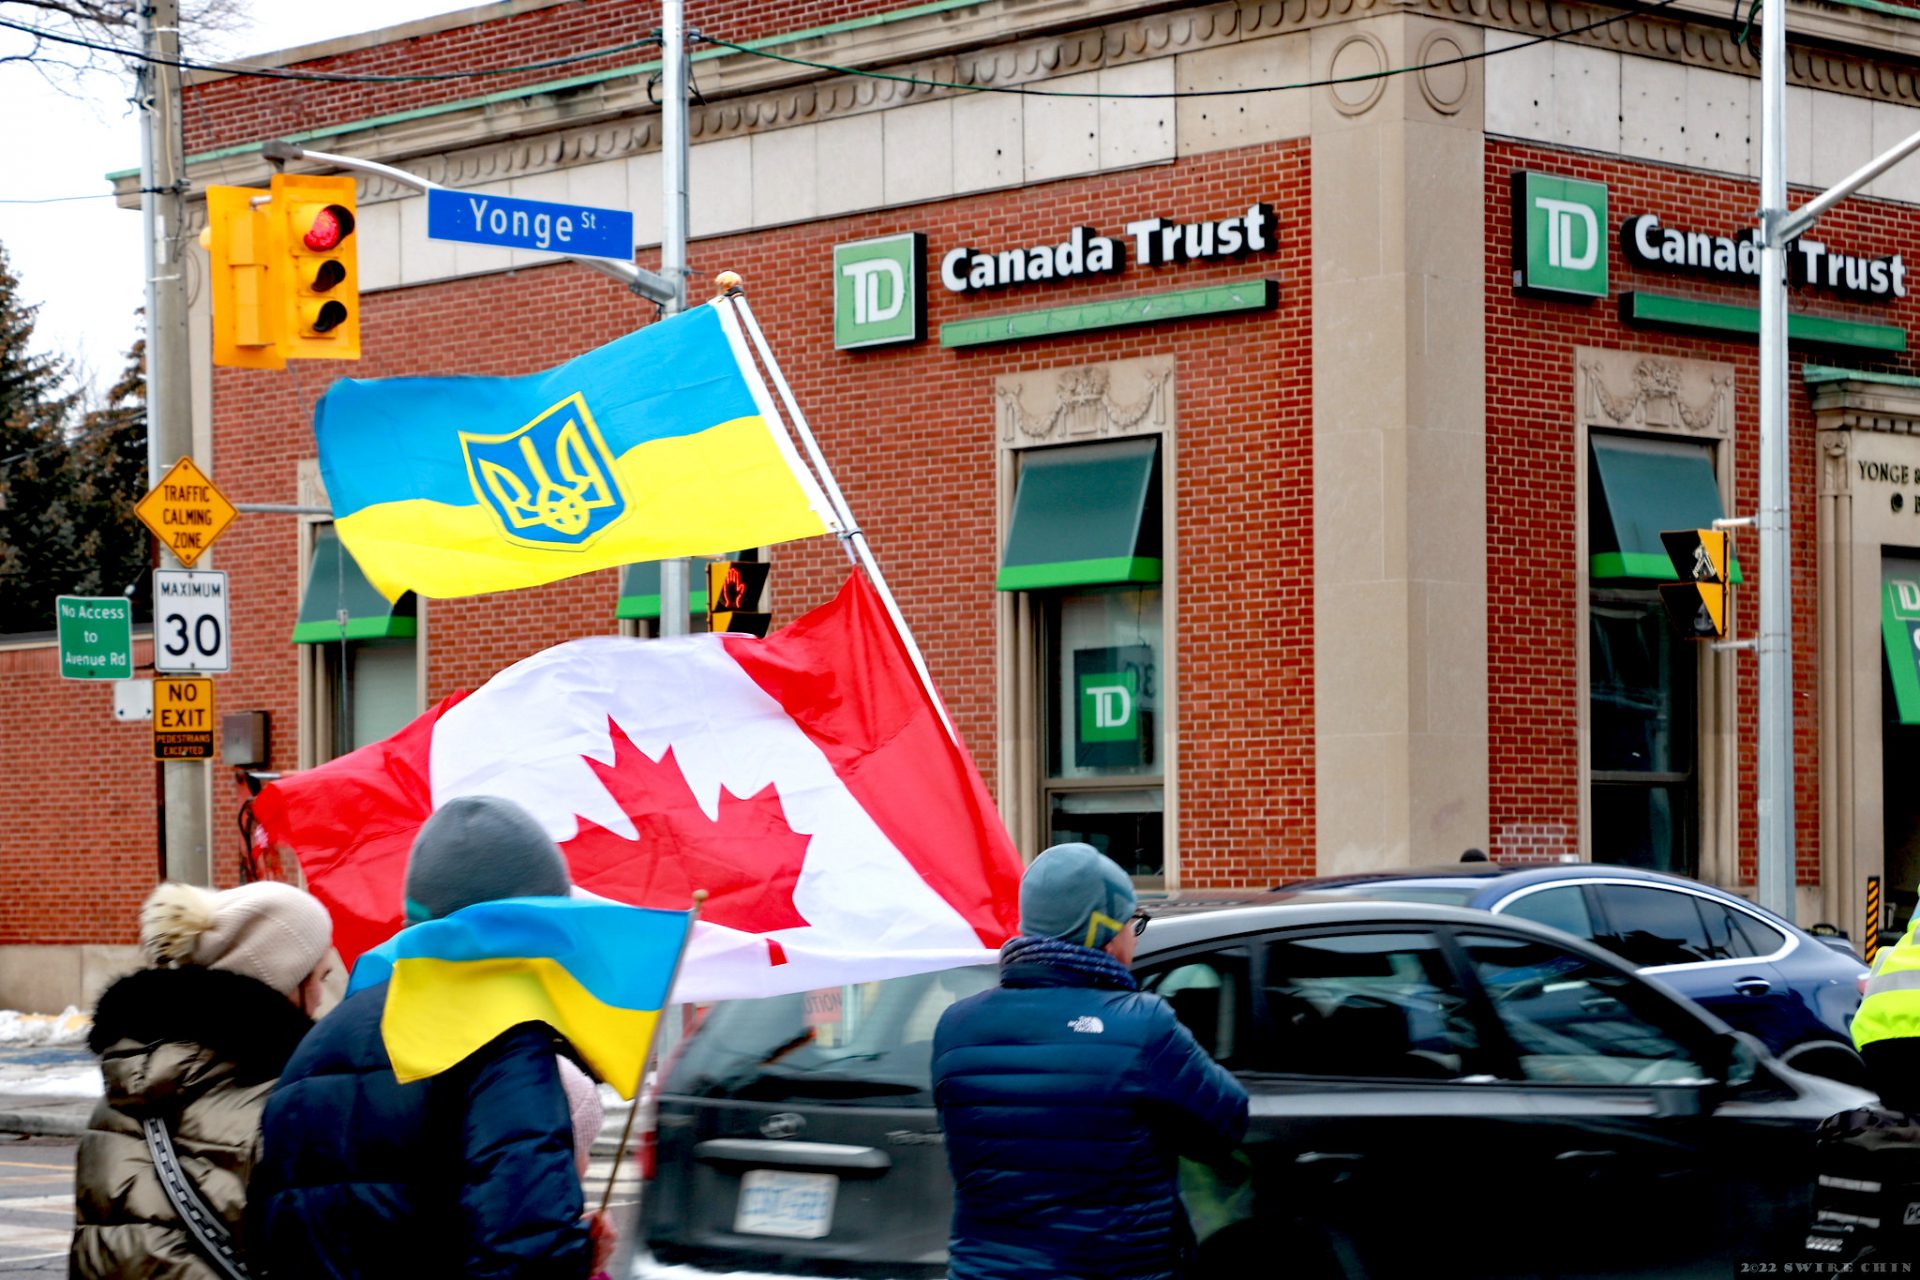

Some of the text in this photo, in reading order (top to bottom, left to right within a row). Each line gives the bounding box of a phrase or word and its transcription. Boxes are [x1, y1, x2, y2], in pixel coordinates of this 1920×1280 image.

[470, 198, 597, 248] Yonge St
[1535, 197, 1907, 298] TD Canad Trust
[842, 203, 1267, 325] TD Canada Trust
[1857, 460, 1909, 485] YONGE
[163, 485, 210, 502] TRAFFIC
[163, 508, 212, 526] CALMING
[173, 532, 202, 549] ZONE
[161, 582, 221, 598] MAXIMUM
[62, 604, 124, 619] No Access
[84, 630, 98, 643] to
[165, 613, 221, 657] 30
[65, 651, 126, 666] Avenue Rd
[169, 683, 197, 702] NO
[1086, 685, 1131, 728] TD
[161, 709, 205, 727] EXIT
[156, 734, 210, 743] PEDESTRIANS
